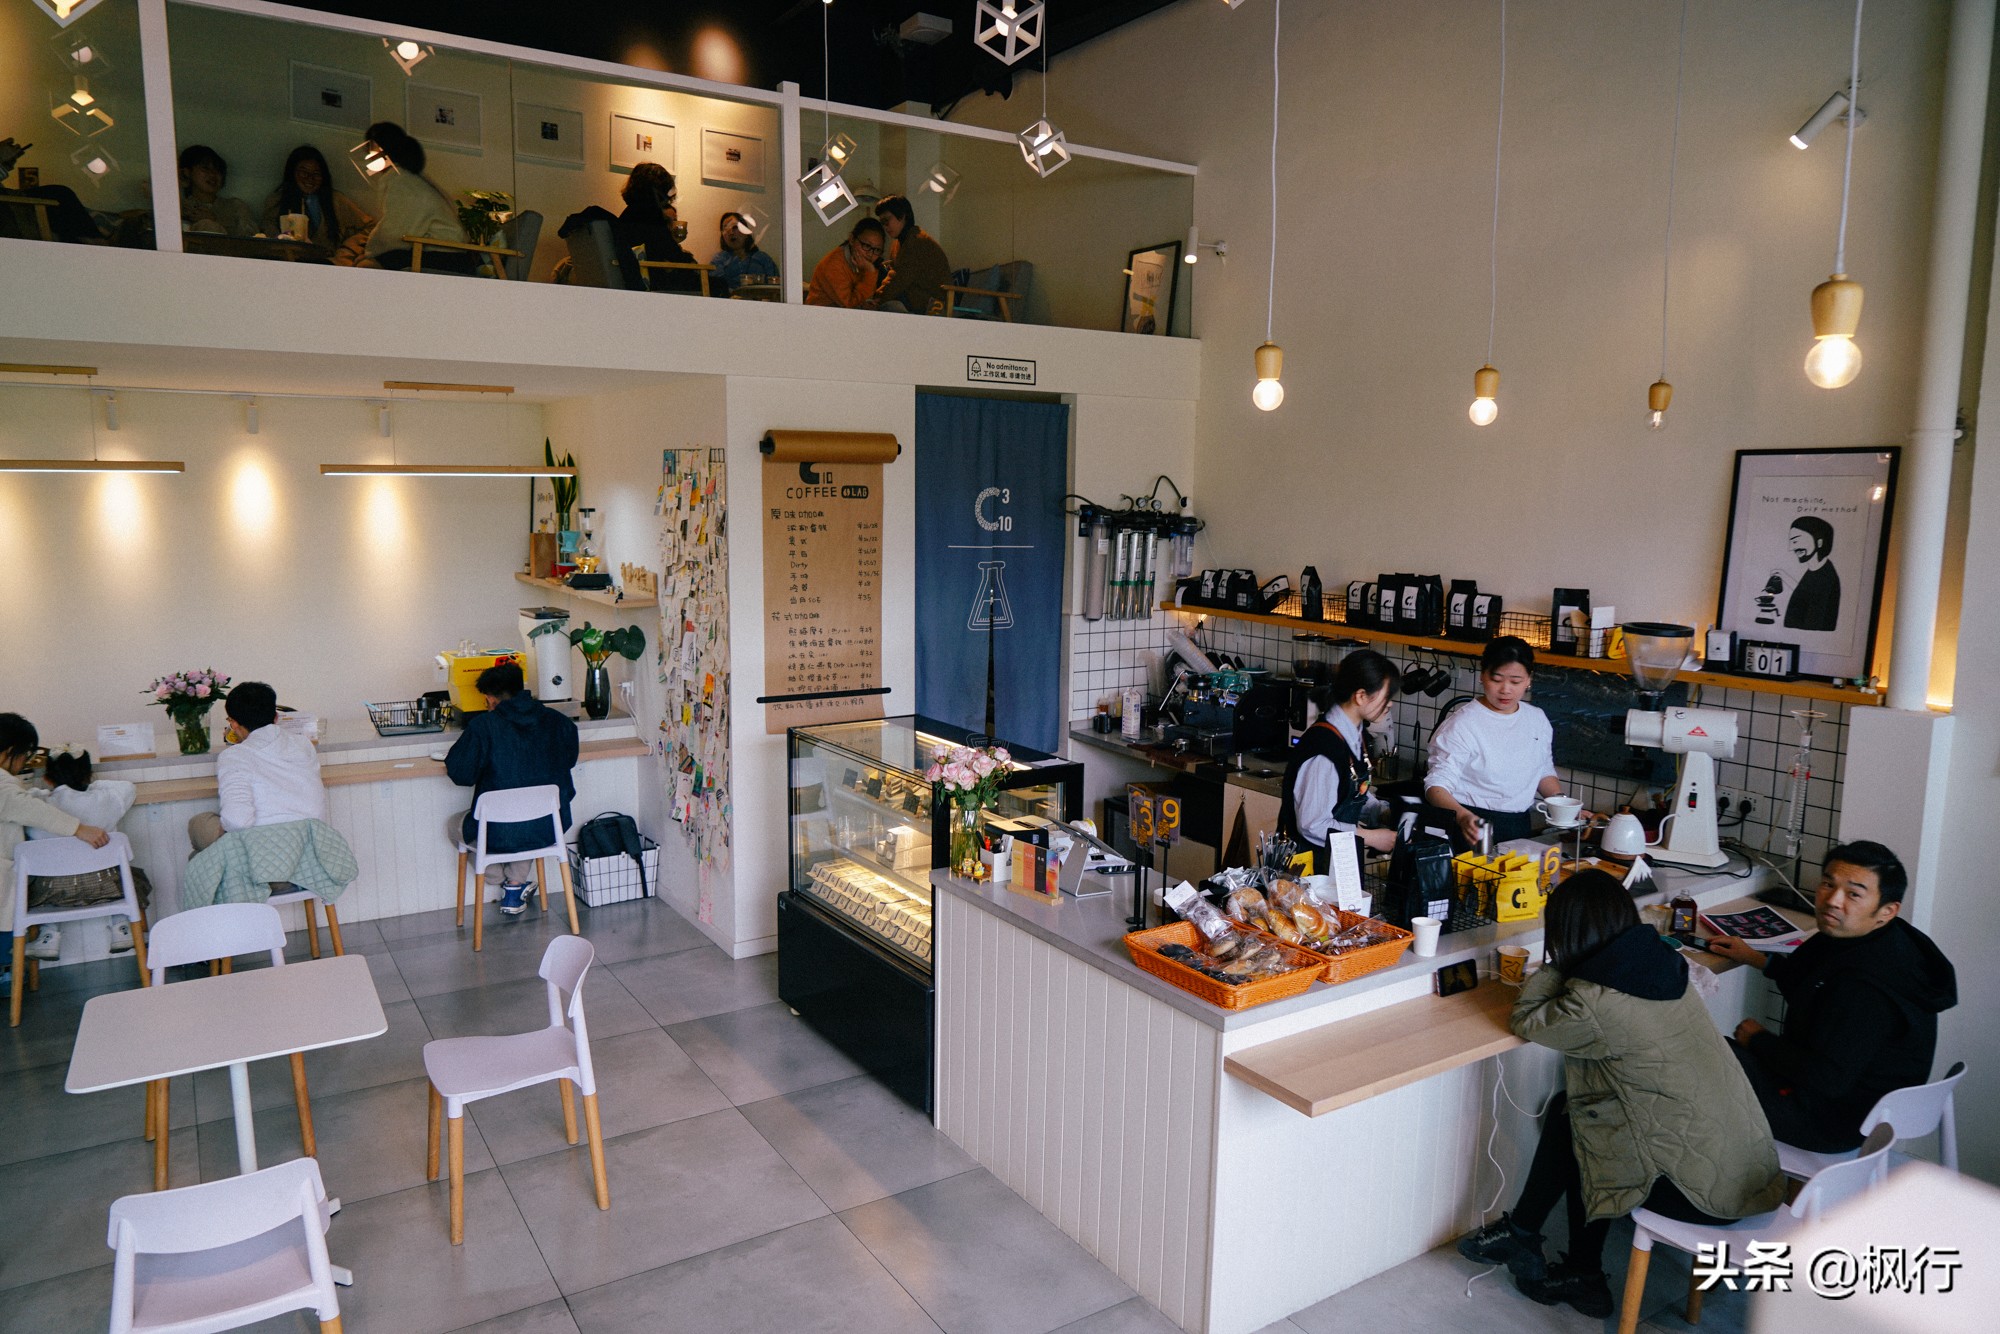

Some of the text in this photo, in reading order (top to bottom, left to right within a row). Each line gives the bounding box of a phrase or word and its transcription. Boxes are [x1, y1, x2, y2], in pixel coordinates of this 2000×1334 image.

[996, 363, 1028, 372] admittance
[787, 487, 868, 499] COFFEE LAB
[1762, 495, 1779, 503] Not
[770, 508, 825, 520] 原味咖啡
[790, 561, 809, 570] Dirty
[1758, 654, 1783, 673] 01
[1162, 799, 1179, 829] 9
[1140, 806, 1154, 836] 3
[1544, 847, 1560, 875] 6
